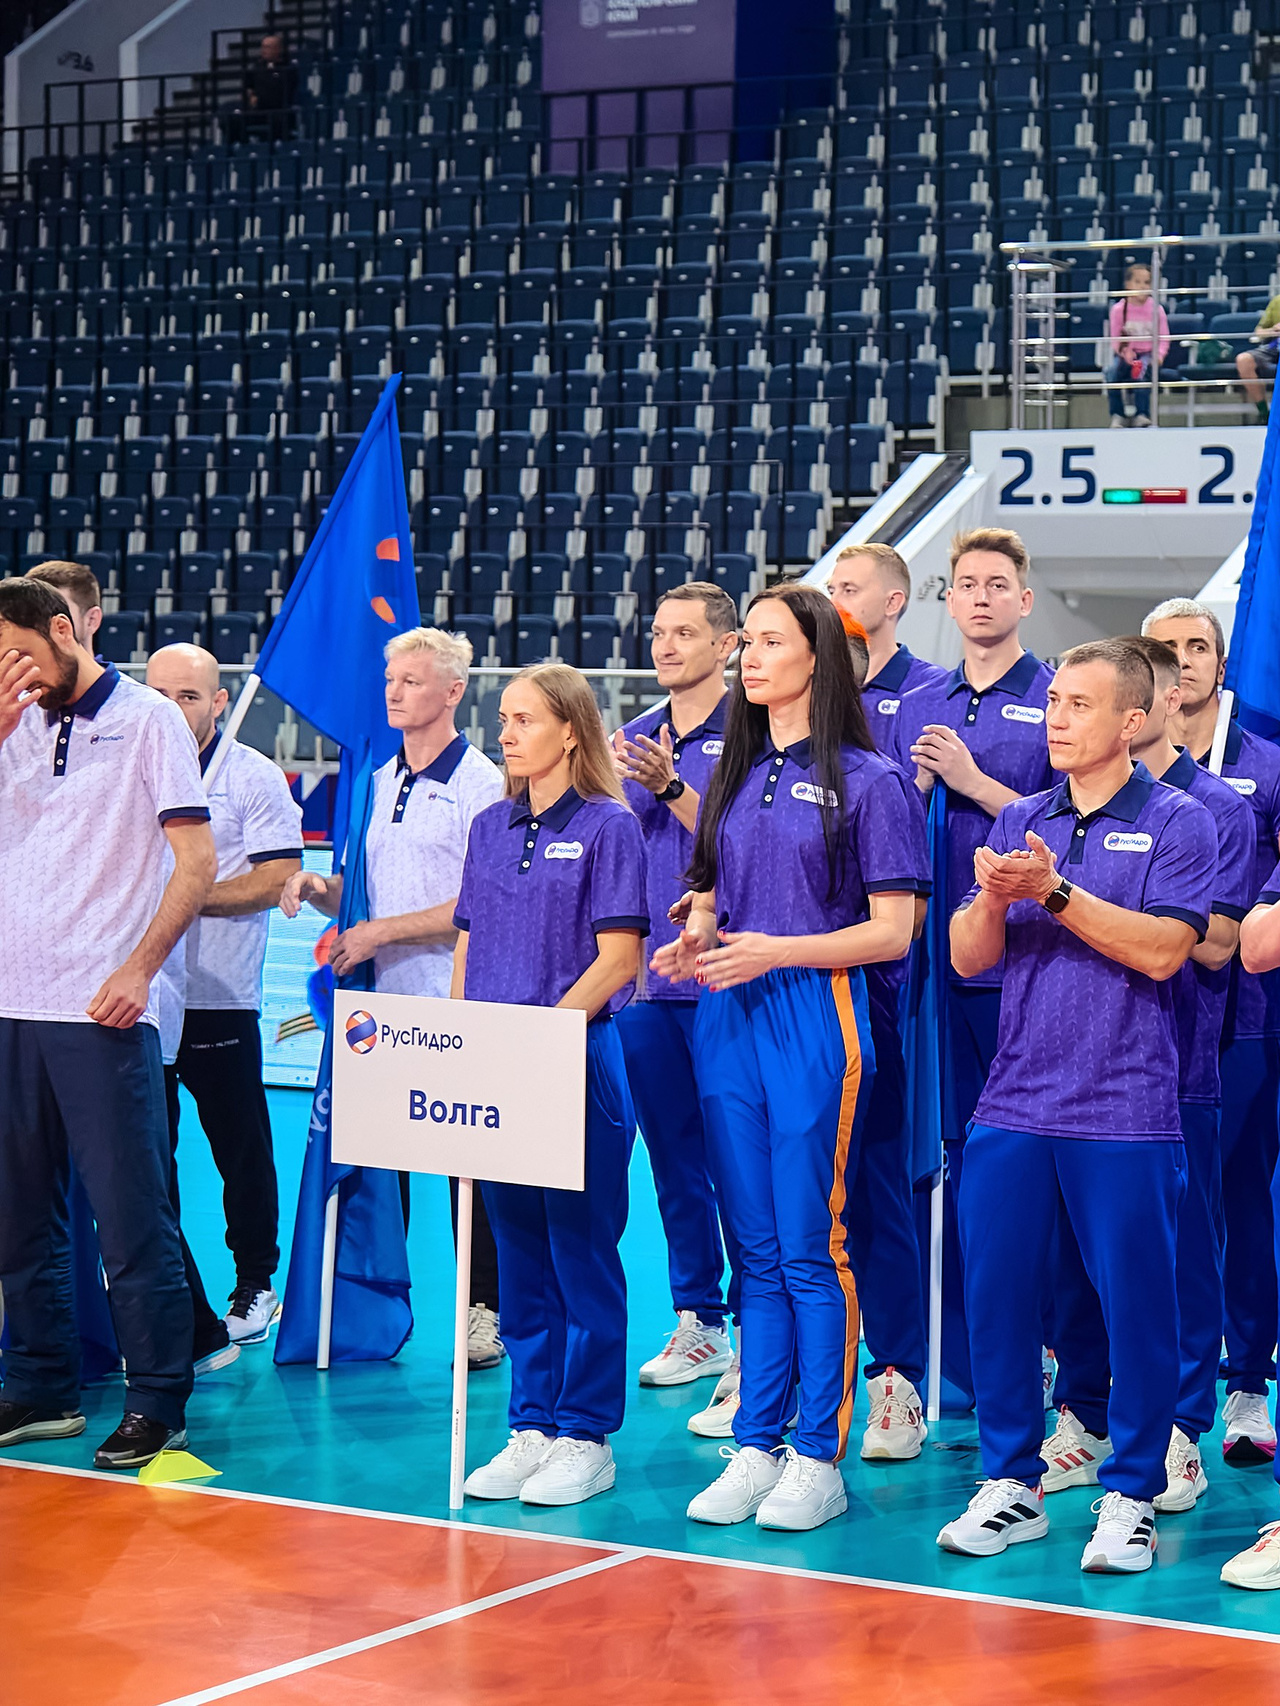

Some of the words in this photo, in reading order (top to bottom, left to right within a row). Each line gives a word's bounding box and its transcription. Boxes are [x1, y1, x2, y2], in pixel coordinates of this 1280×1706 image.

[999, 447, 1096, 505] 2.5
[381, 1024, 463, 1052] РусГидро
[409, 1089, 500, 1129] Волга
